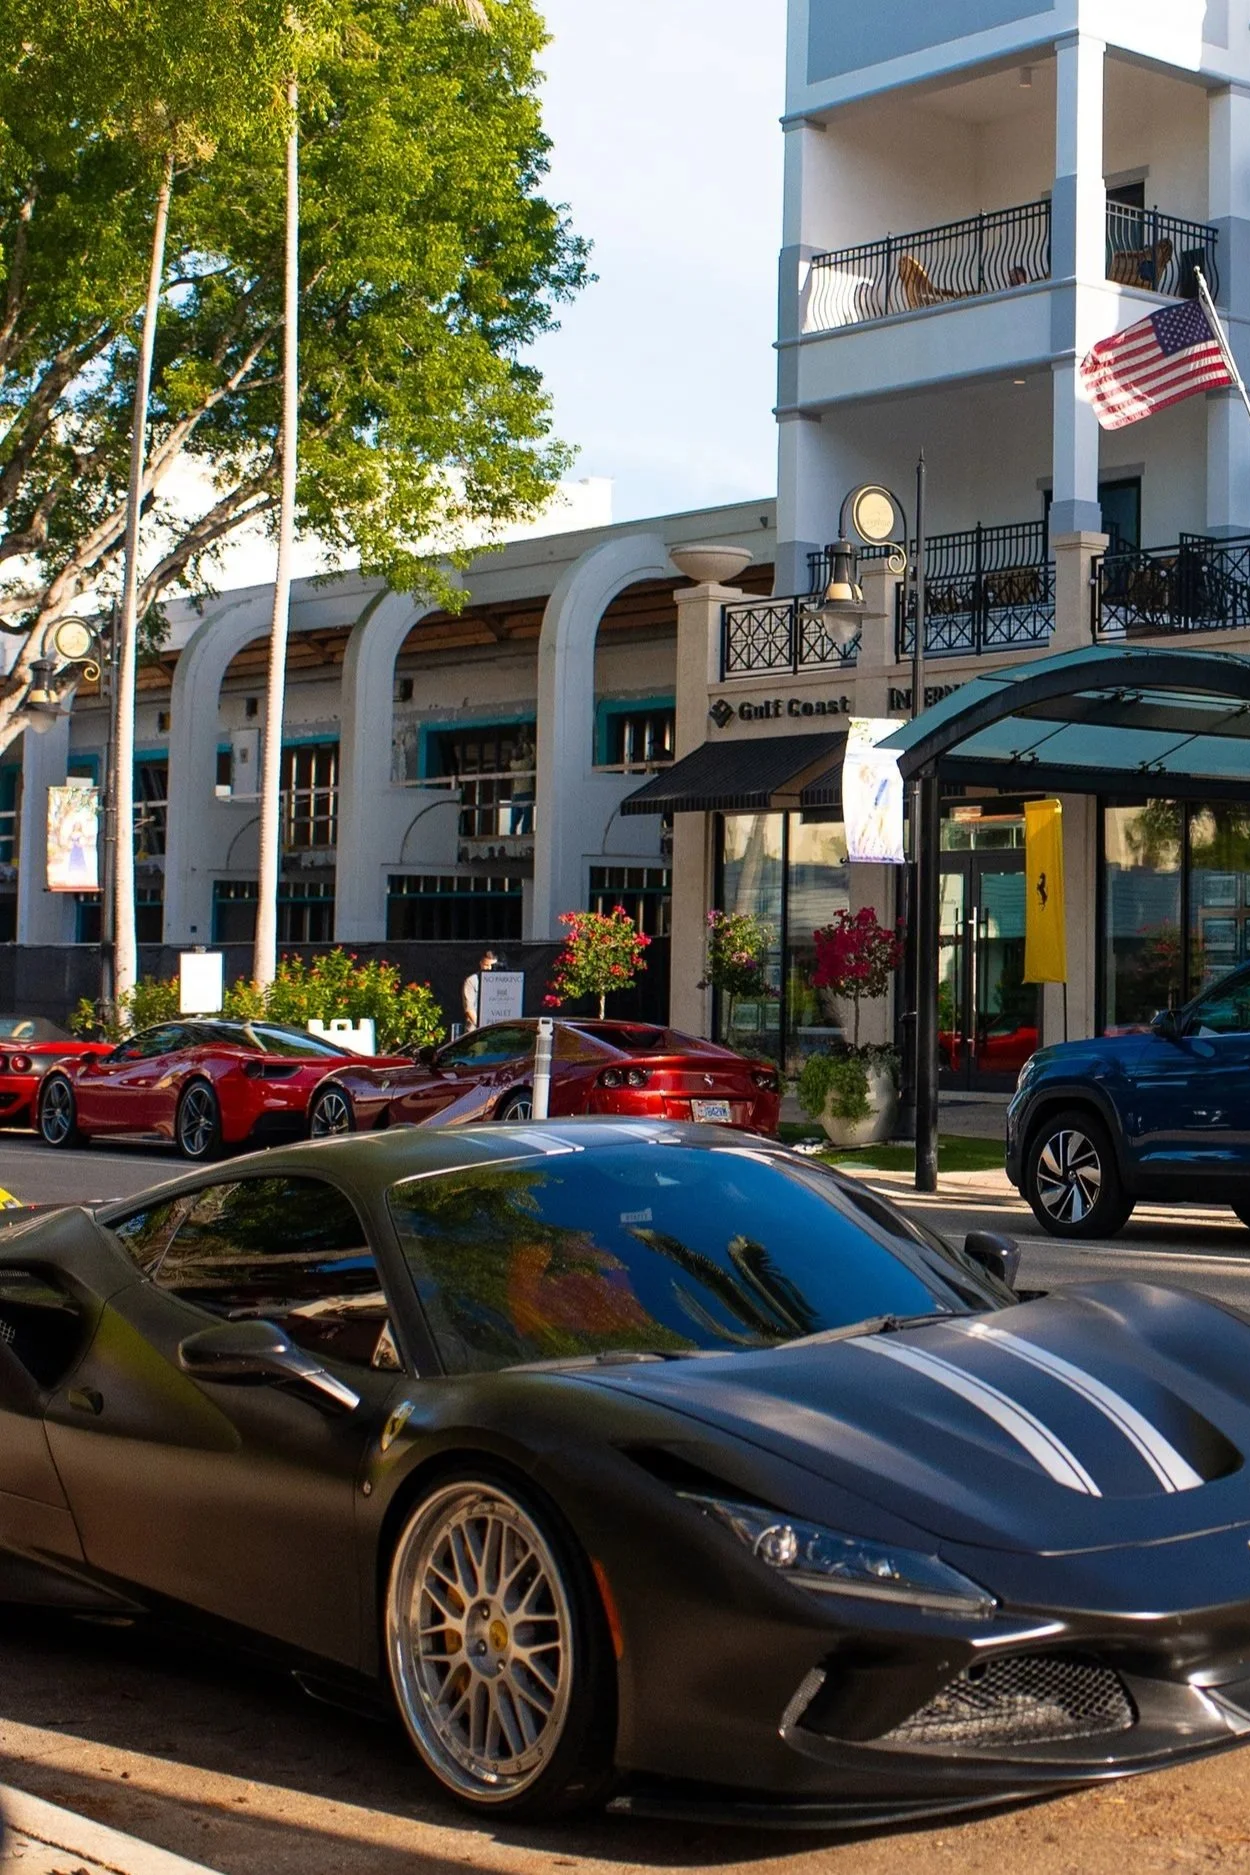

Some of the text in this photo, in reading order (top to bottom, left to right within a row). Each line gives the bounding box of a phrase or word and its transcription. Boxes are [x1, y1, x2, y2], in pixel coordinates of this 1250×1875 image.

[738, 696, 850, 720] Gulf Coast
[490, 1009, 511, 1017] VALET
